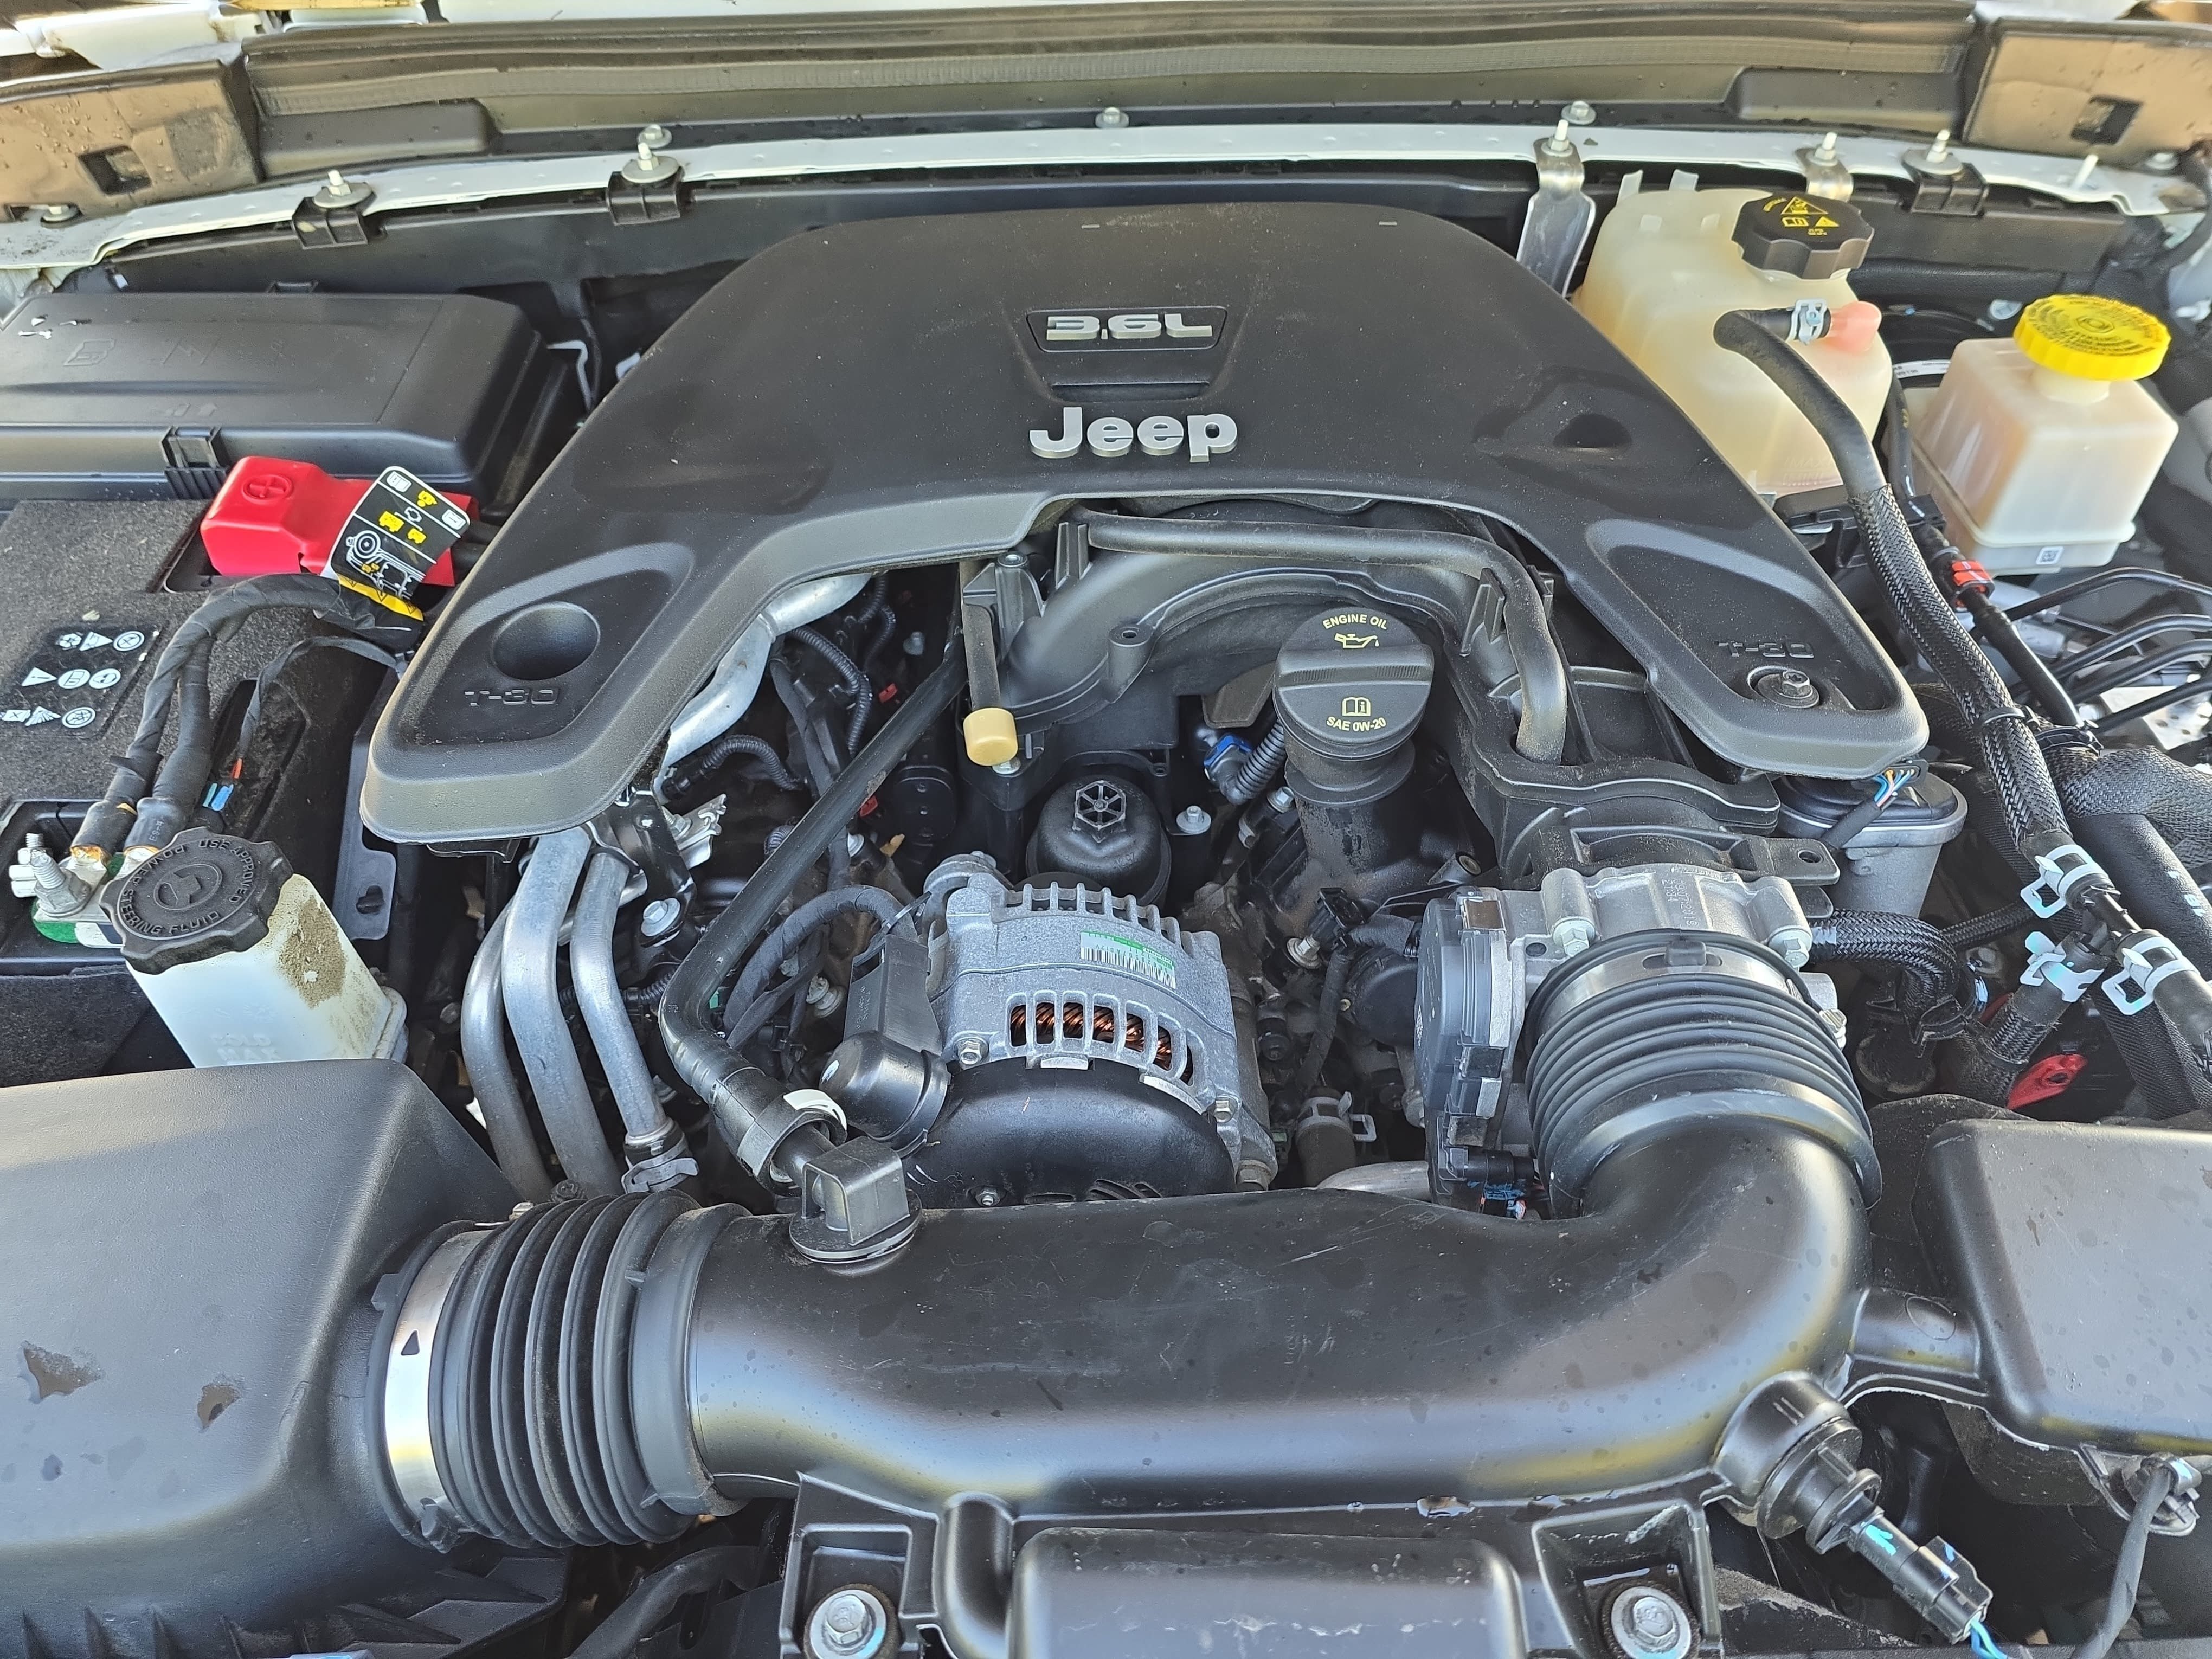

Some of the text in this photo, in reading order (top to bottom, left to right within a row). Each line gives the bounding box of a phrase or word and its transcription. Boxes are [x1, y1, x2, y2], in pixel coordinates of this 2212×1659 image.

[1046, 314, 1213, 340] 3.6L
[1029, 407, 1238, 463] Jeep
[1323, 614, 1387, 630] ENGINE OIL
[1718, 641, 1814, 658] T-30
[464, 687, 561, 706] T-30
[1326, 716, 1386, 731] SAE 0W-20
[198, 839, 255, 904] USE APPROVED
[119, 845, 221, 935] POWER STEERING FLUID
